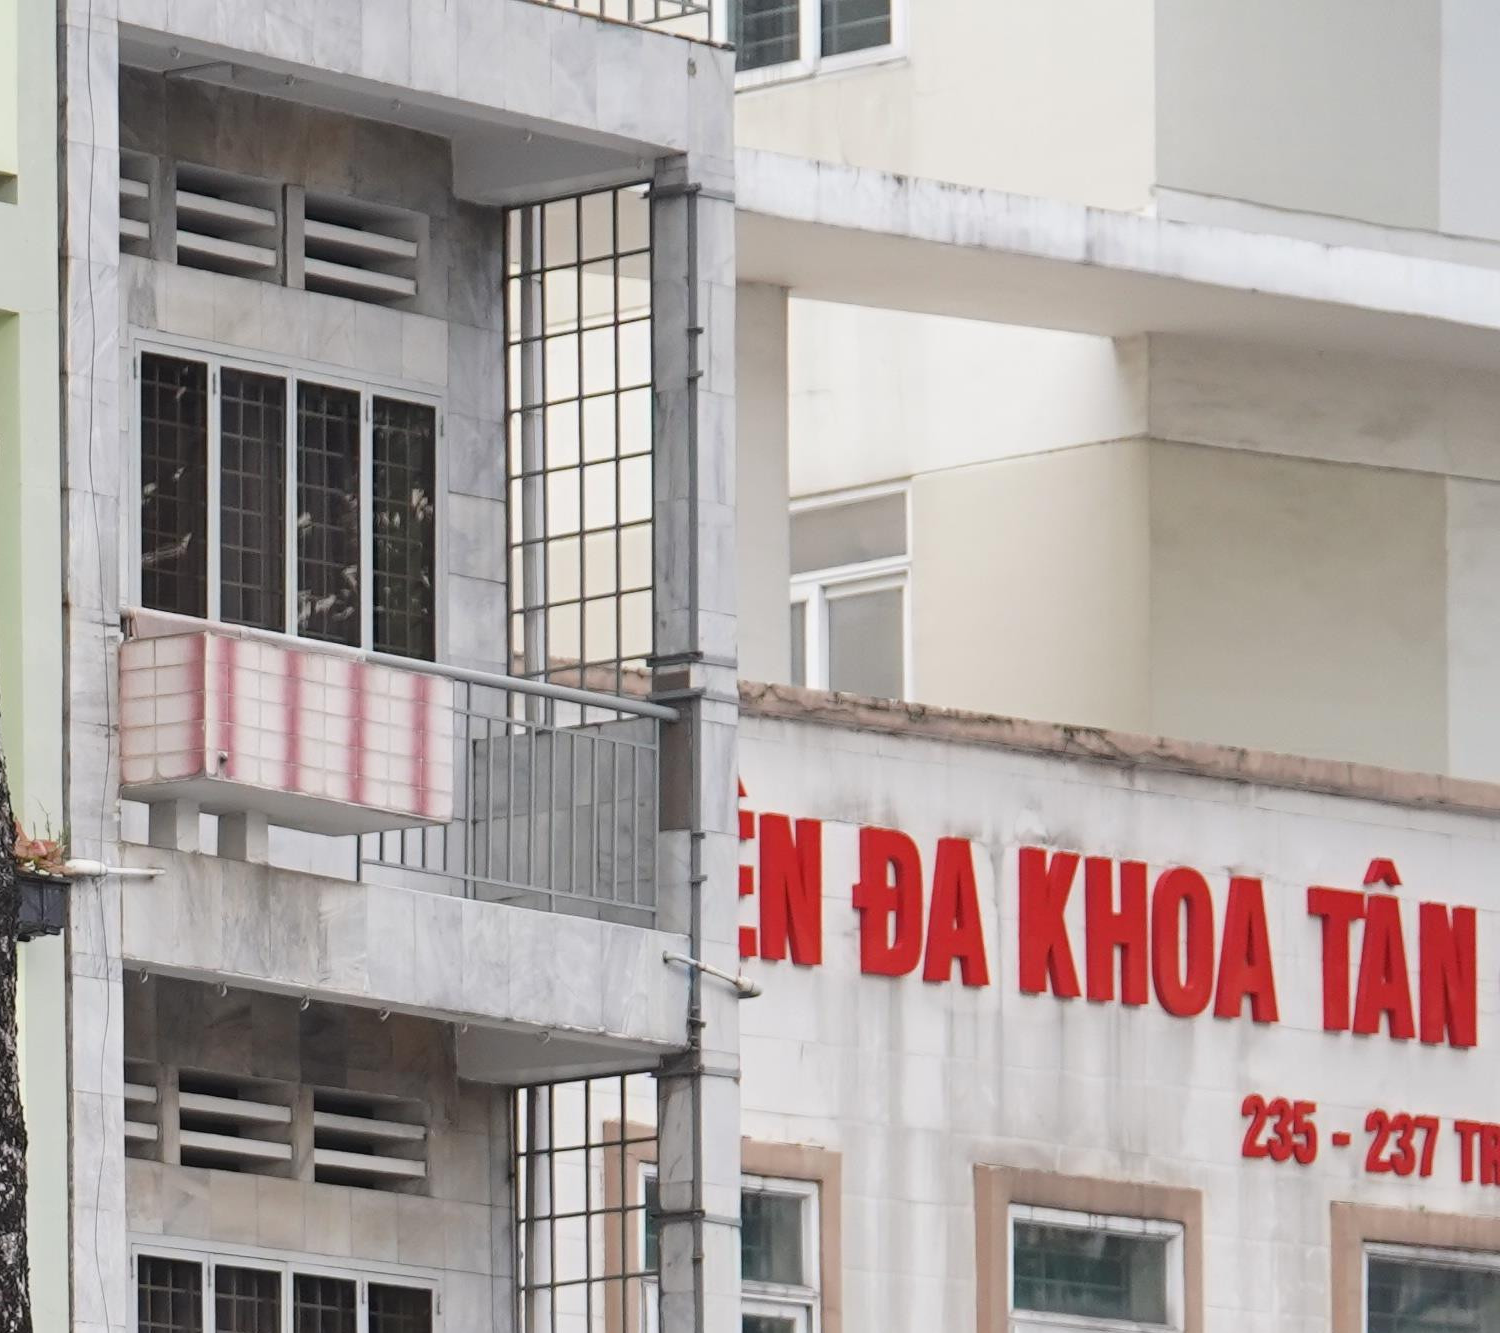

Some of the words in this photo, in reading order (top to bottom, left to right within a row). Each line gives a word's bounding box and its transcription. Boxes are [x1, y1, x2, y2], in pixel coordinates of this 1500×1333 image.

[853, 825, 990, 988] ĐA
[1019, 845, 1279, 1024] KHOA
[1307, 857, 1478, 1047] TÂN
[1241, 1093, 1318, 1165] 235
[1365, 1109, 1440, 1177] 237
